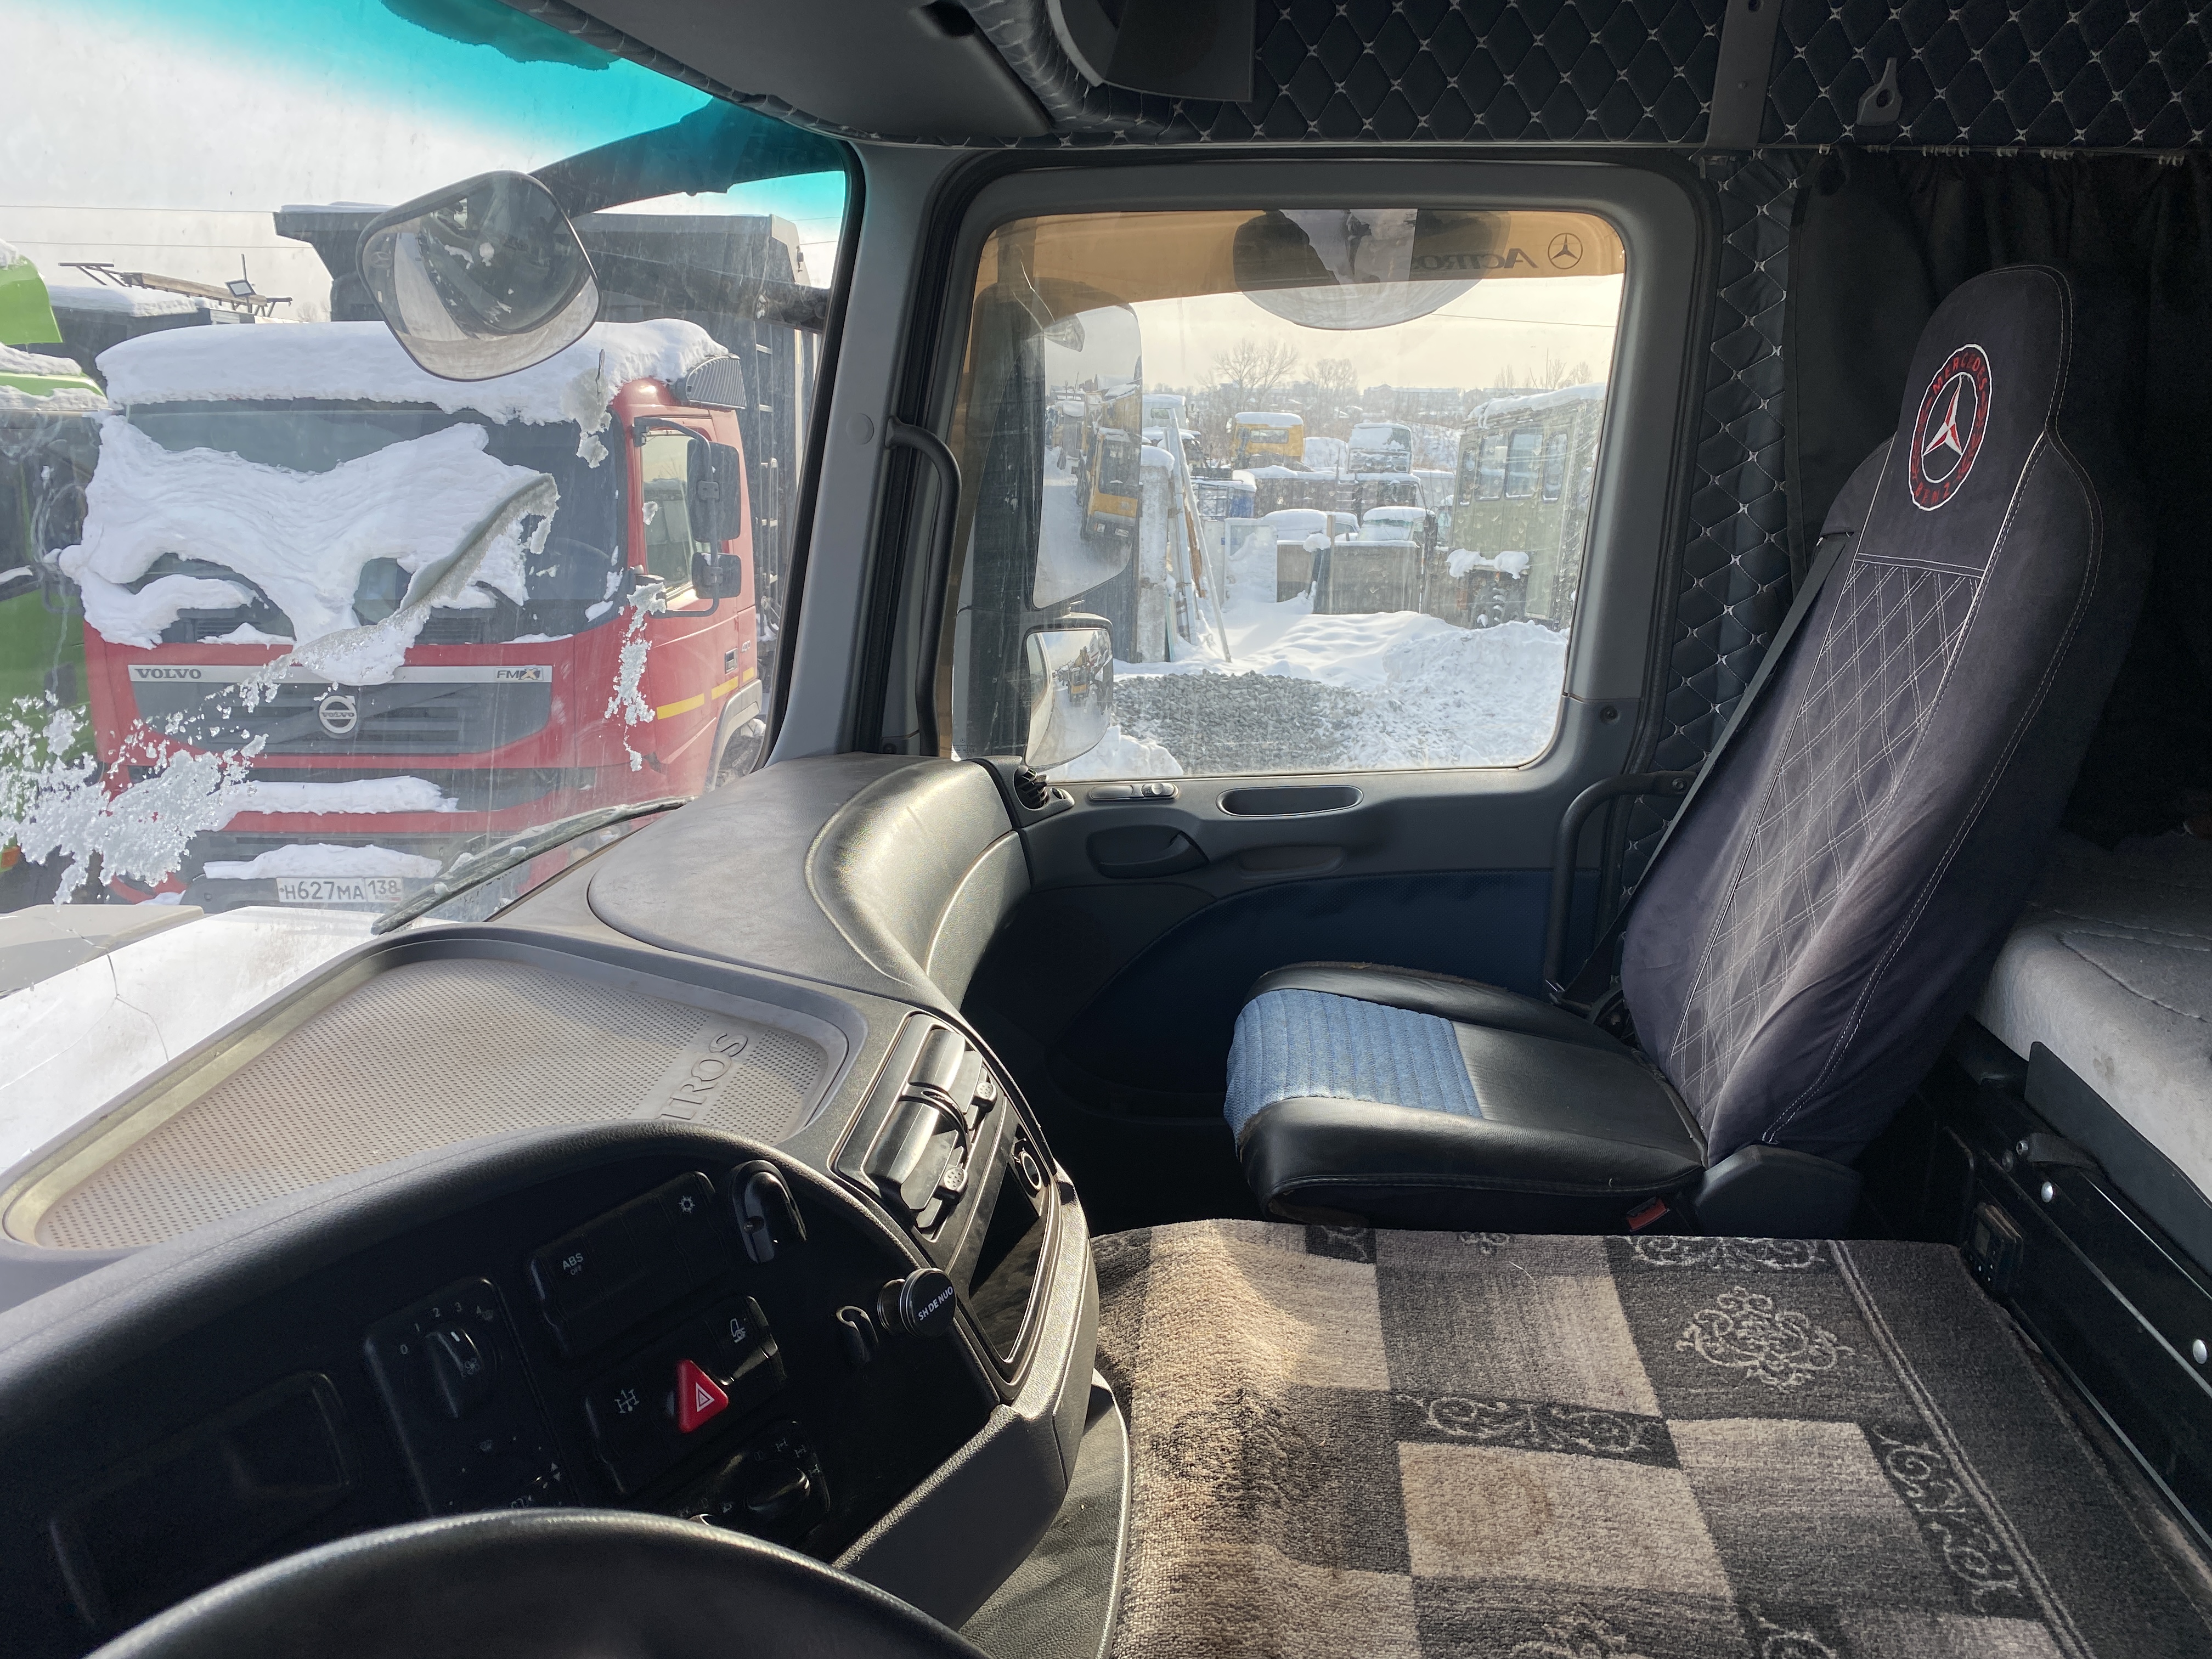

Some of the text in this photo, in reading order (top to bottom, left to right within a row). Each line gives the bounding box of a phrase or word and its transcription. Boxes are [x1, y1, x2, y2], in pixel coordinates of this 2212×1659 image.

[1932, 352, 1988, 396] MERCEDES
[1915, 481, 1950, 505] BENZ
[134, 668, 201, 679] VOLVO
[496, 668, 541, 680] FMX
[368, 879, 397, 895] 138
[562, 1252, 583, 1271] ABS
